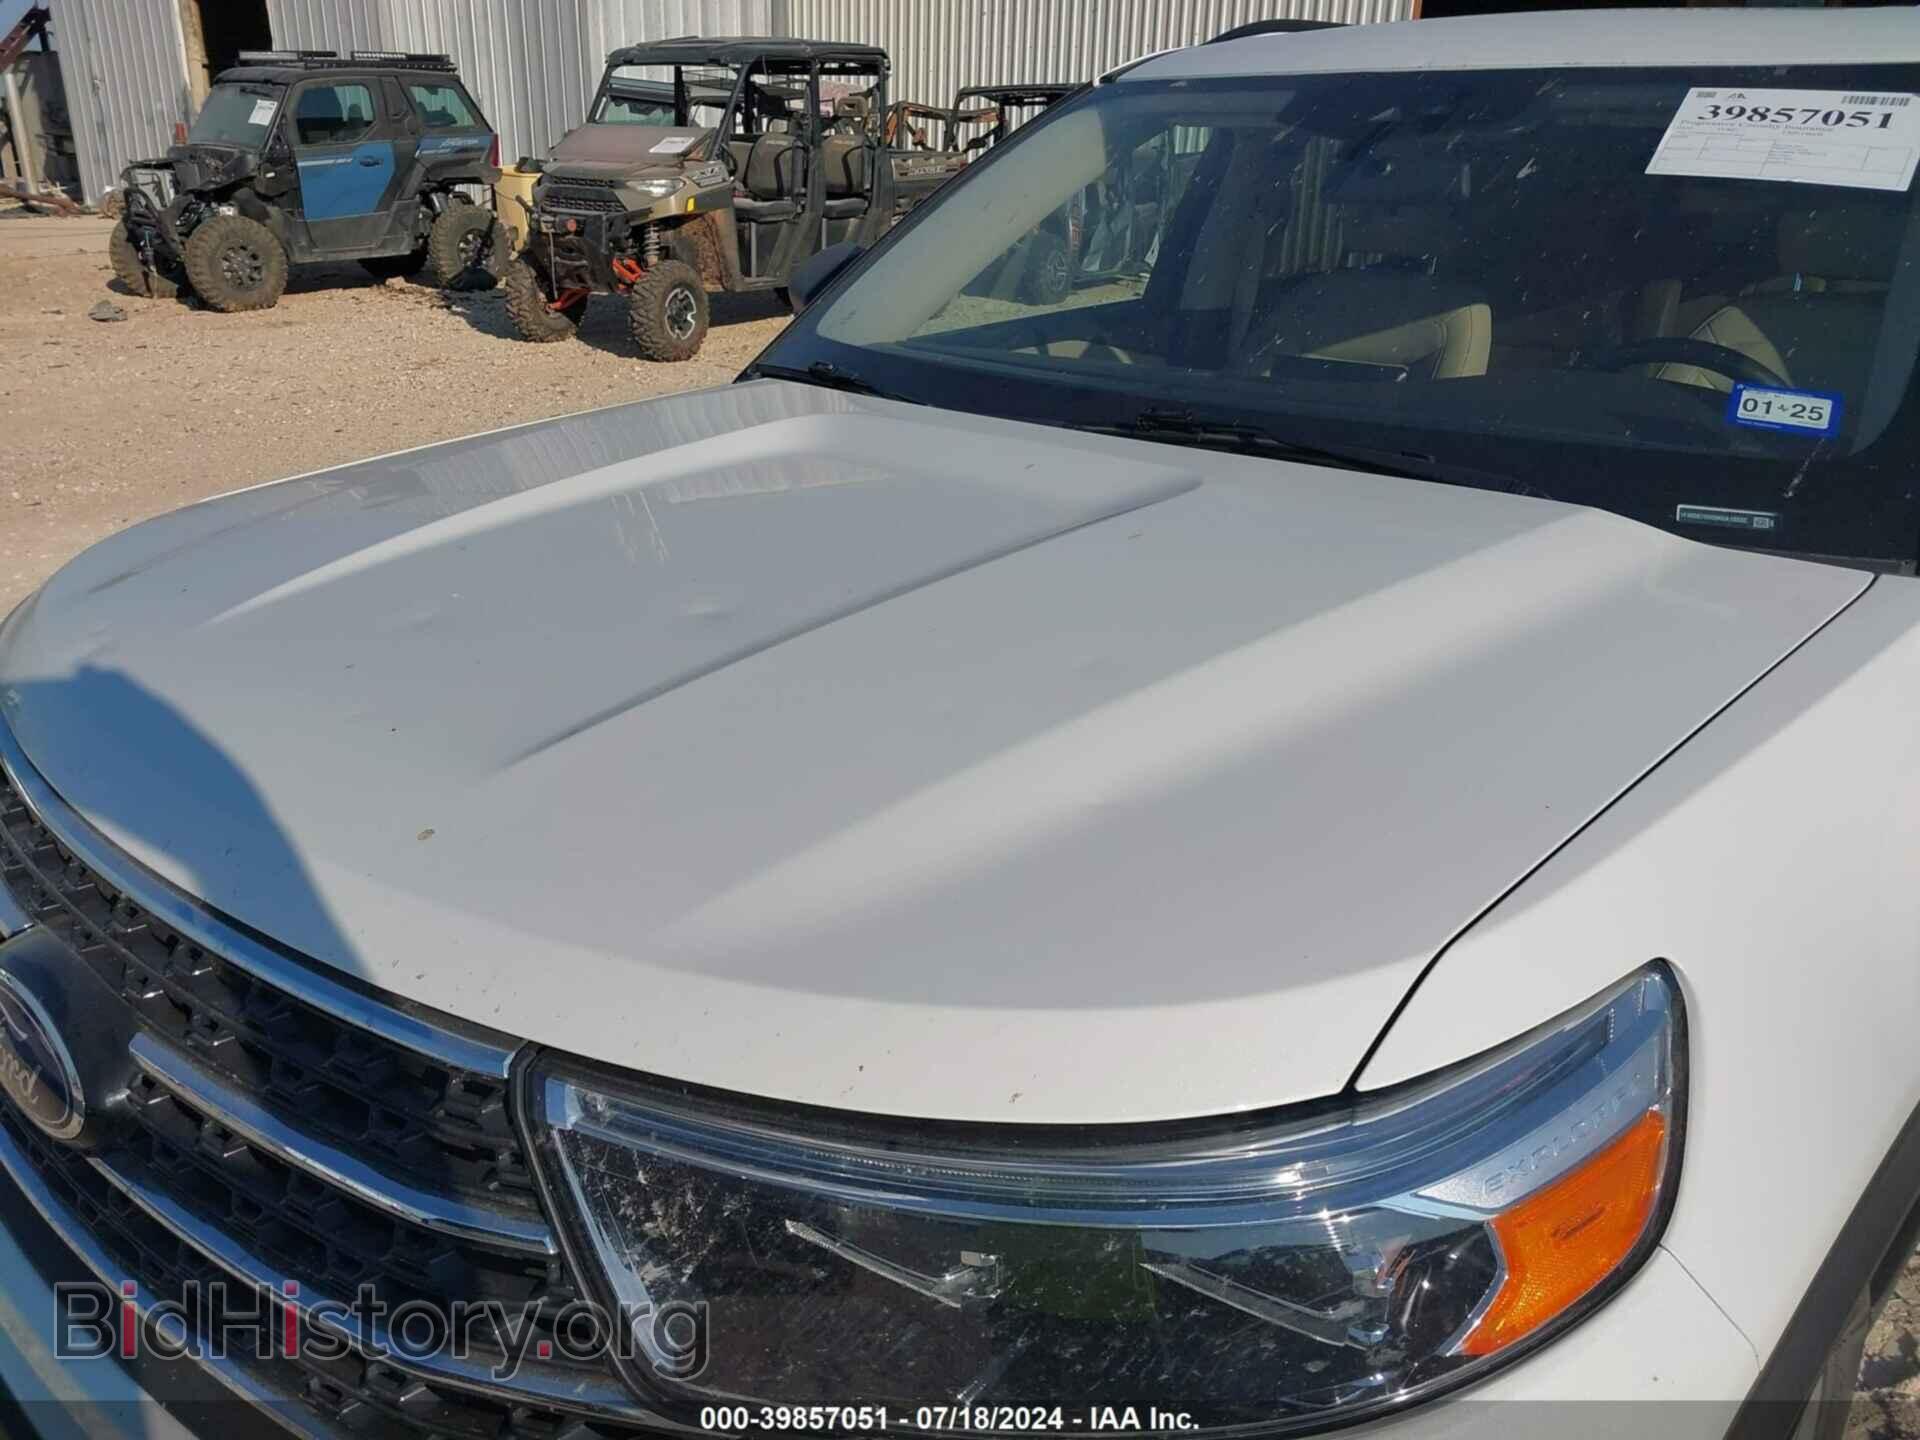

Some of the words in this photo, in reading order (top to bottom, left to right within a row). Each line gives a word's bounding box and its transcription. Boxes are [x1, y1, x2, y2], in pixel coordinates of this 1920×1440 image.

[1698, 104, 1895, 129] 39857051
[1742, 398, 1774, 415] 01
[1790, 404, 1825, 421] 25
